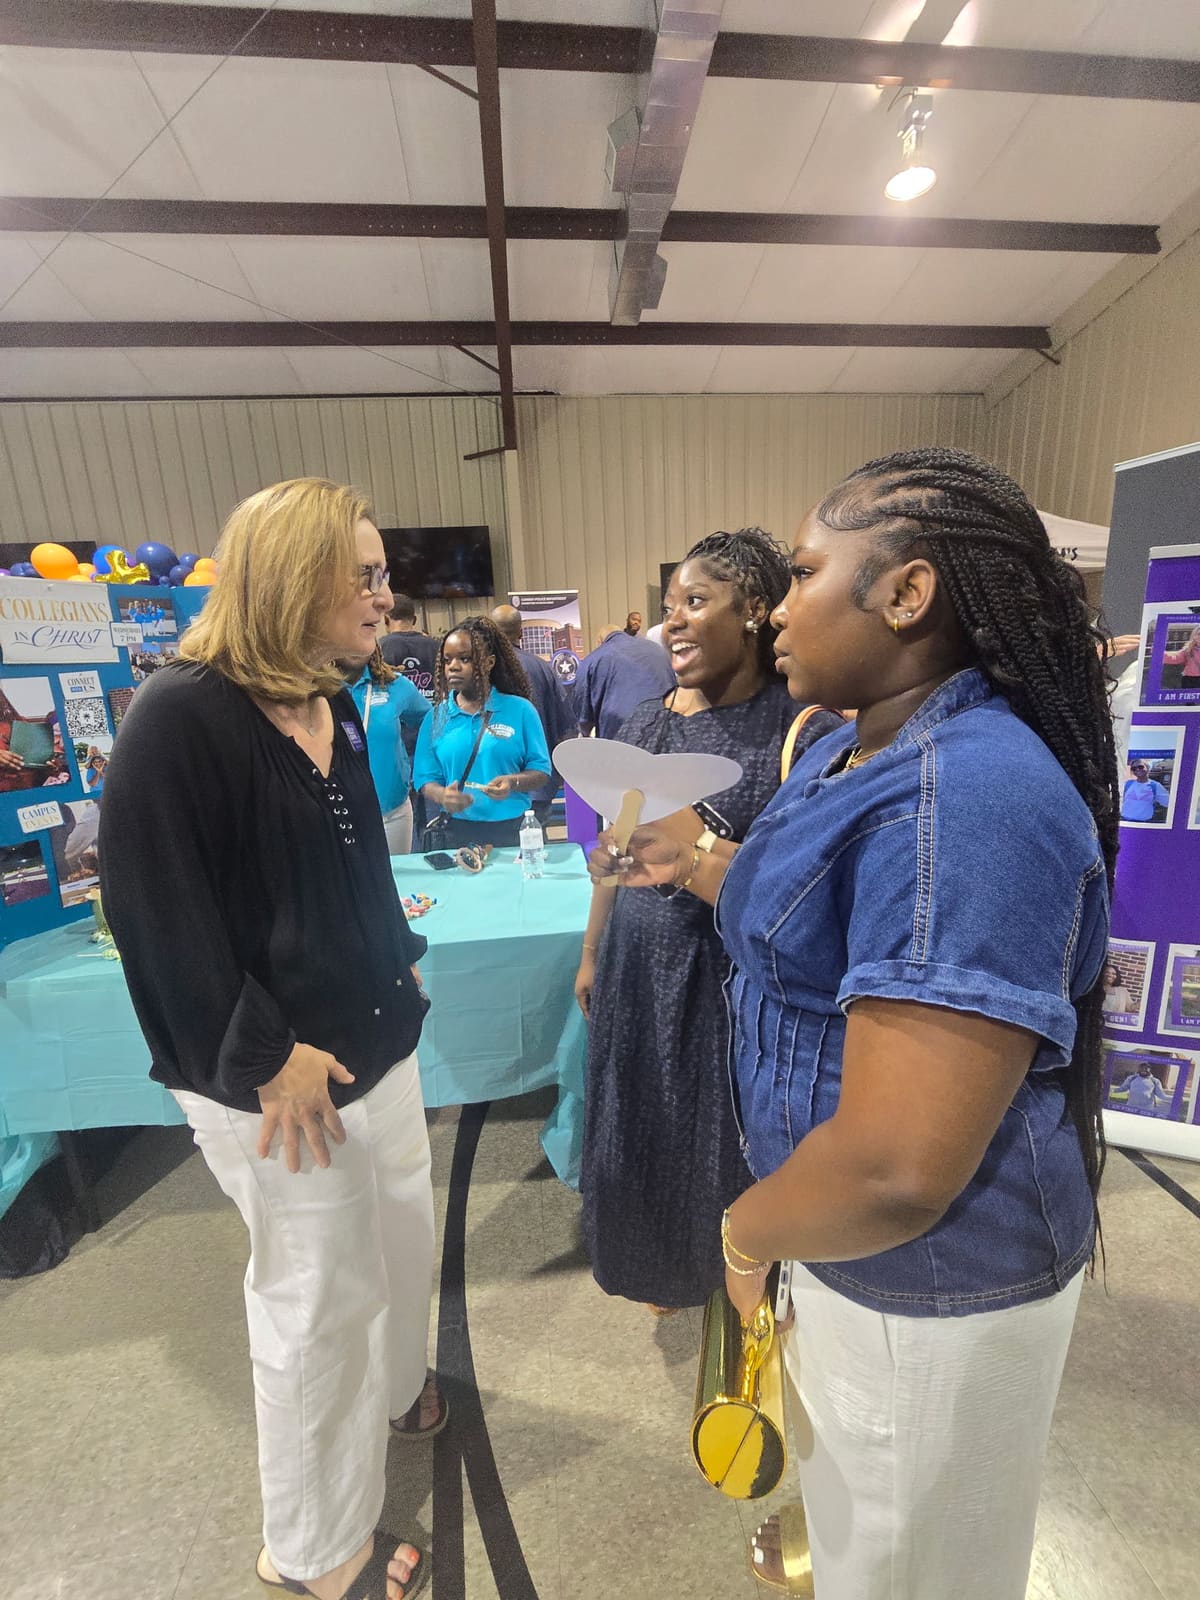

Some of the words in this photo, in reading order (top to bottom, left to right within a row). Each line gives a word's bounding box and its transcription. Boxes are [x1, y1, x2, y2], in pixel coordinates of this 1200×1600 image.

[0, 598, 109, 622] COLLEGIANS
[14, 631, 30, 641] IN
[31, 625, 108, 650] CHRIST
[67, 677, 95, 686] CONNECT
[83, 685, 95, 693] US
[1164, 693, 1176, 701] AM
[22, 806, 57, 820] CAMPUS
